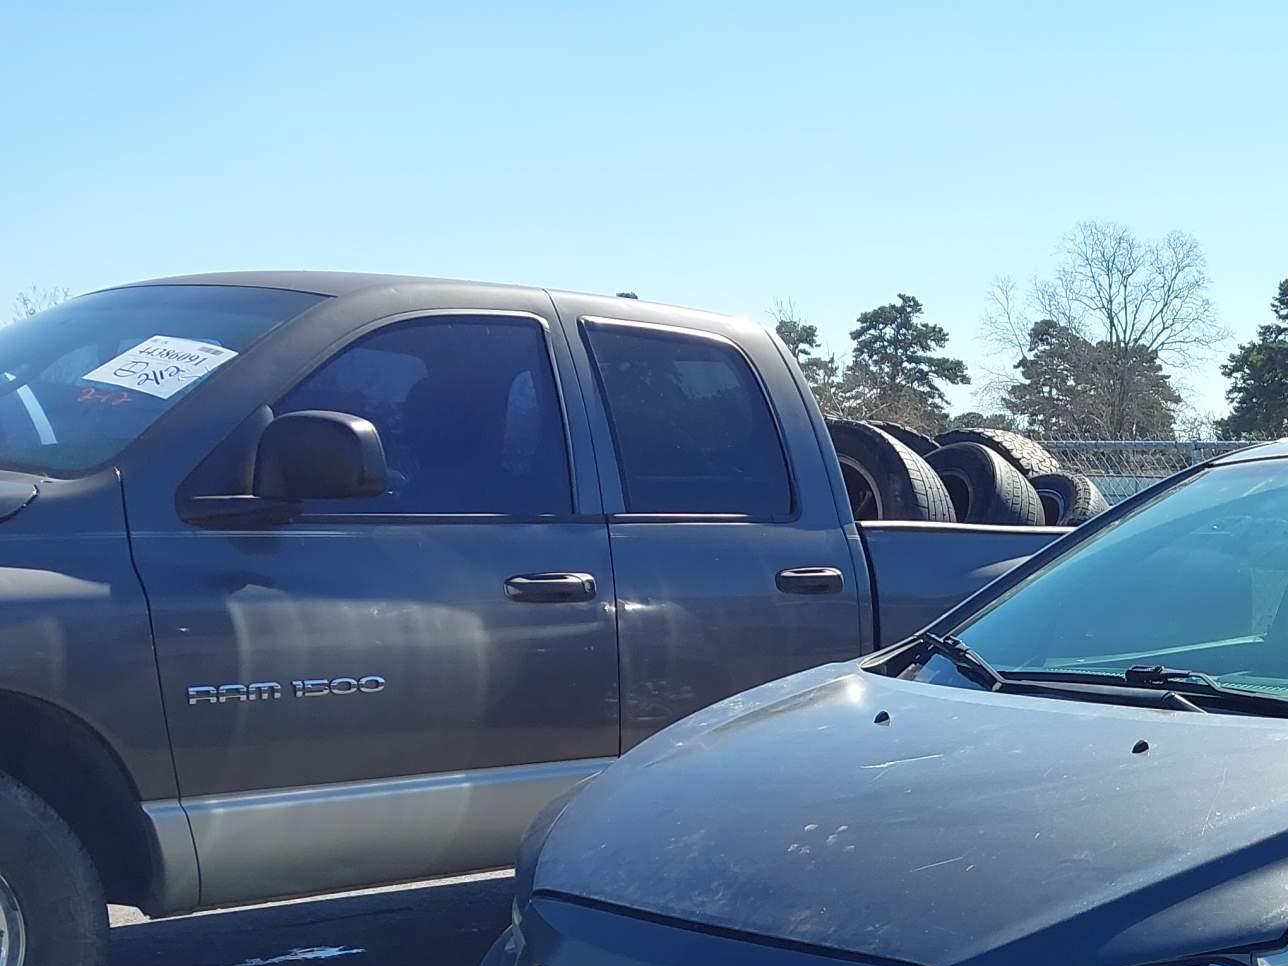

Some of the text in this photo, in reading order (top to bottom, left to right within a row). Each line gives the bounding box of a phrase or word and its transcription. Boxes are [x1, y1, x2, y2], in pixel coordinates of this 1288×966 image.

[138, 346, 208, 366] 44386091
[187, 675, 385, 705] RAM 1500
